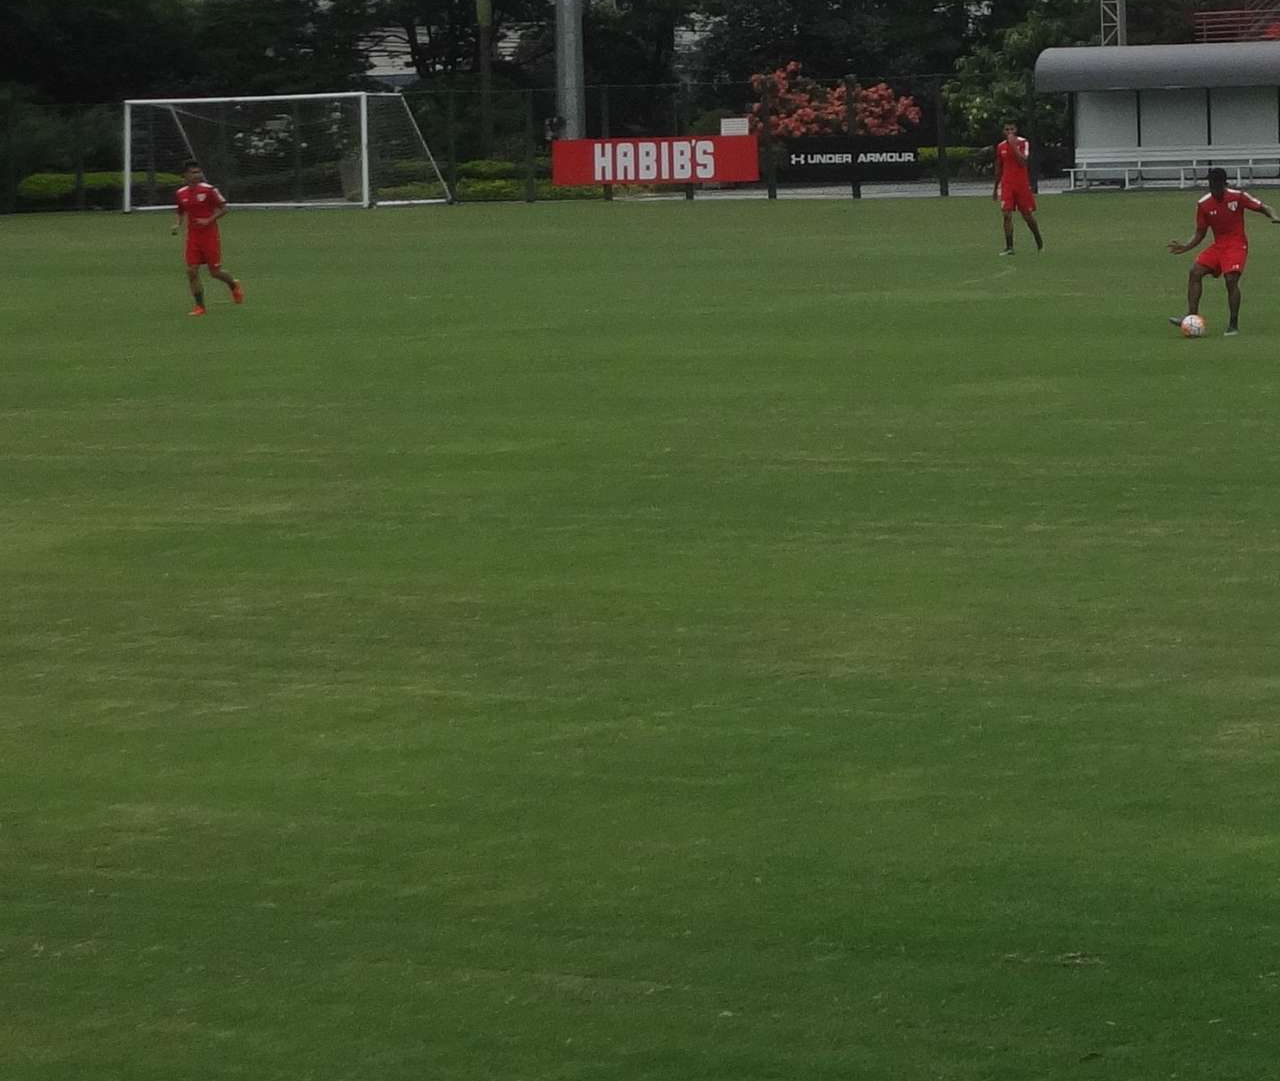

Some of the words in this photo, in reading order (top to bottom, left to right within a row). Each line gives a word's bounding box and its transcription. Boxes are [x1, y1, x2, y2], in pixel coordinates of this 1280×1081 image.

[594, 140, 715, 181] HABIB'S
[807, 154, 852, 164] UNDER
[857, 152, 915, 163] ARMOUR
